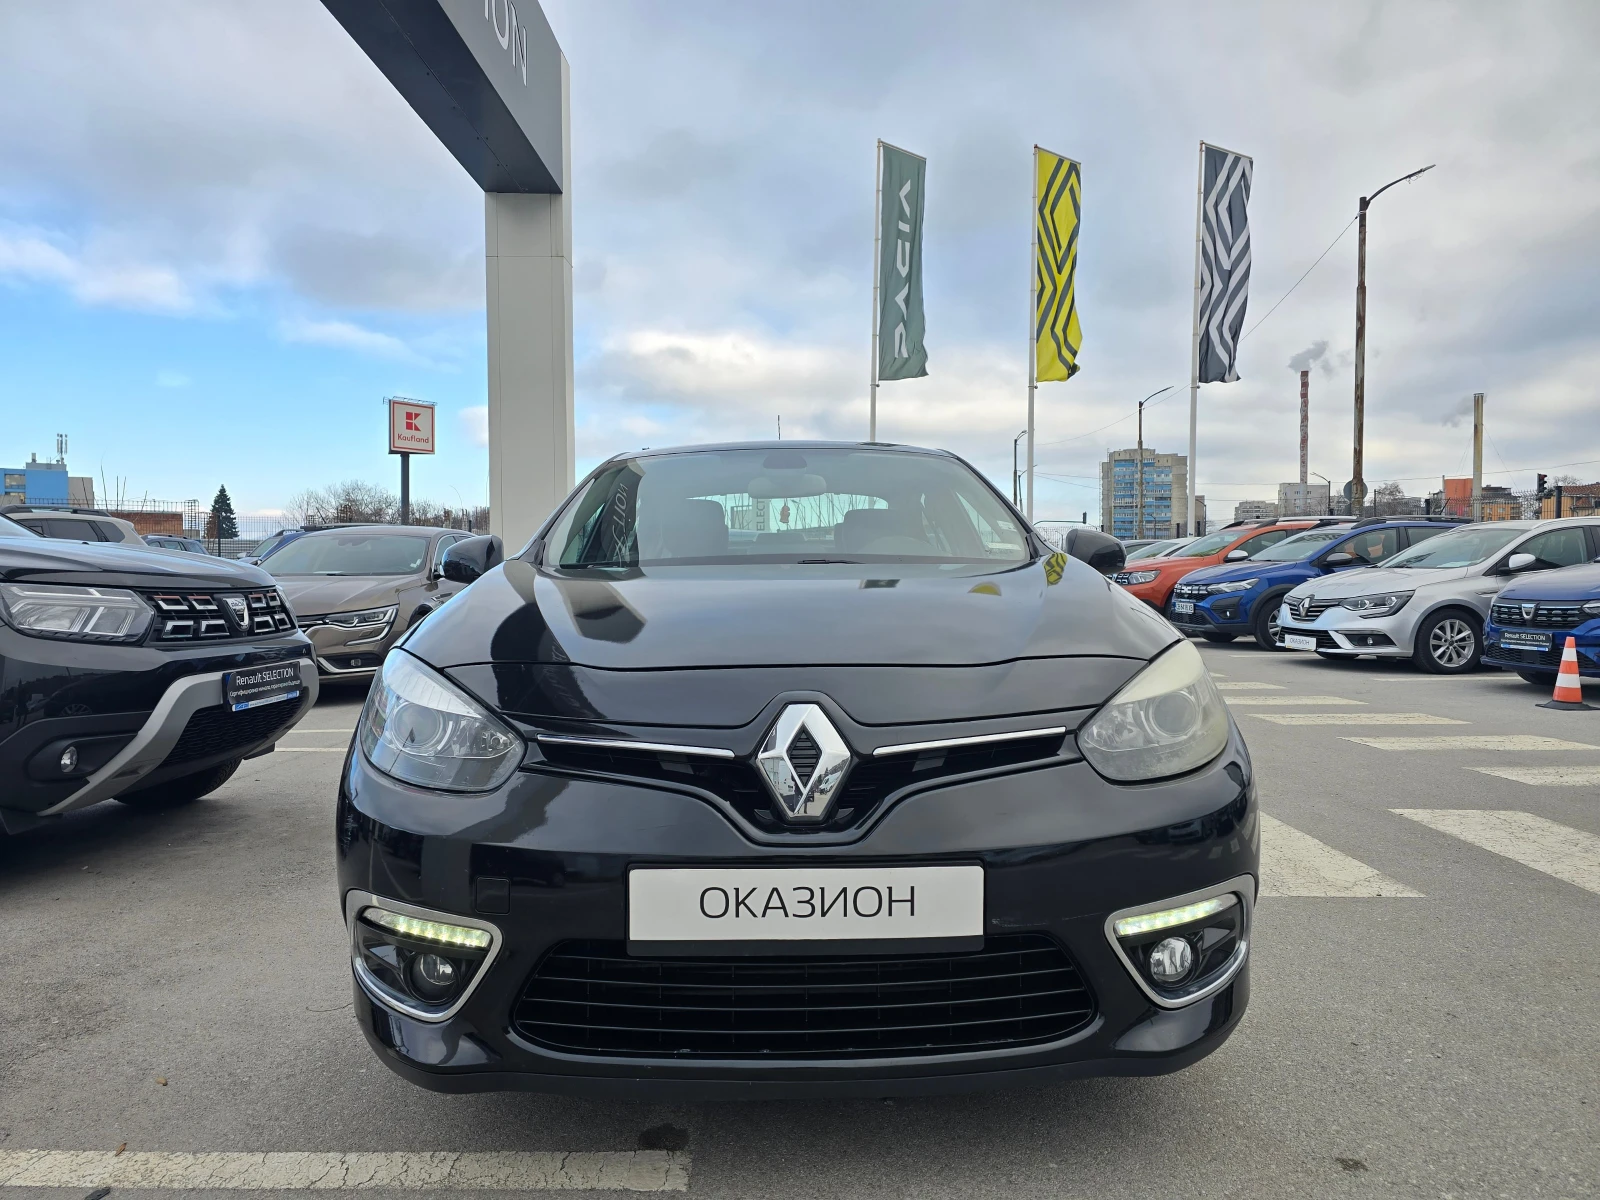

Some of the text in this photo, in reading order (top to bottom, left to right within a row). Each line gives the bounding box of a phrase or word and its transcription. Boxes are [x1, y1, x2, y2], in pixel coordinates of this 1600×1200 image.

[397, 433, 430, 444] Kaufland
[1520, 633, 1546, 641] SELECTION
[236, 667, 294, 687] Renault SELECTION
[699, 885, 916, 919] ОКАЗИОН
